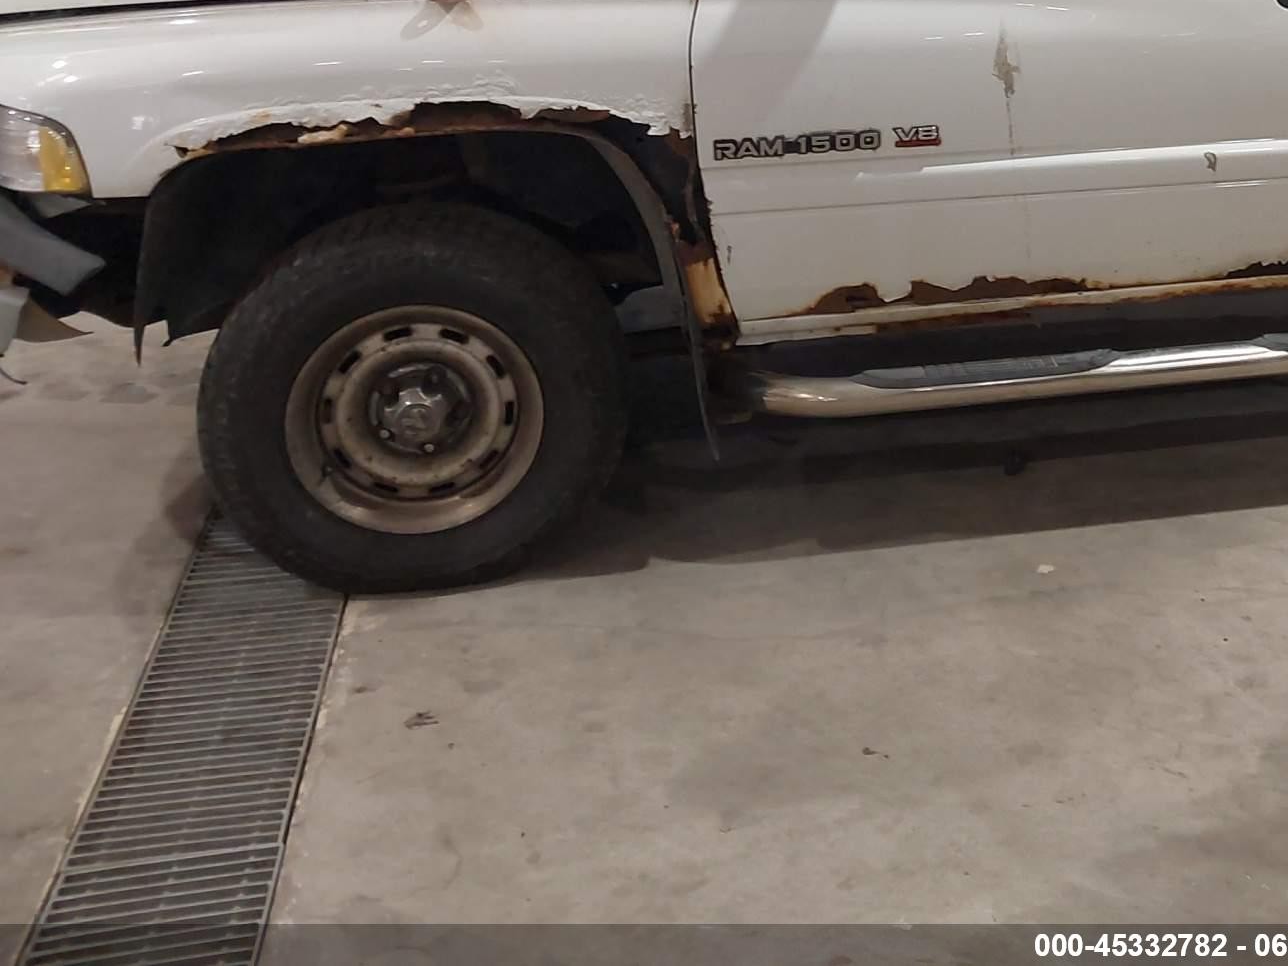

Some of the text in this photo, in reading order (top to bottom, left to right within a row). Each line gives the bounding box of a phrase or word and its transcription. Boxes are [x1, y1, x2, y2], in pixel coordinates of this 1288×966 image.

[714, 125, 941, 160] RAM 1500 V8
